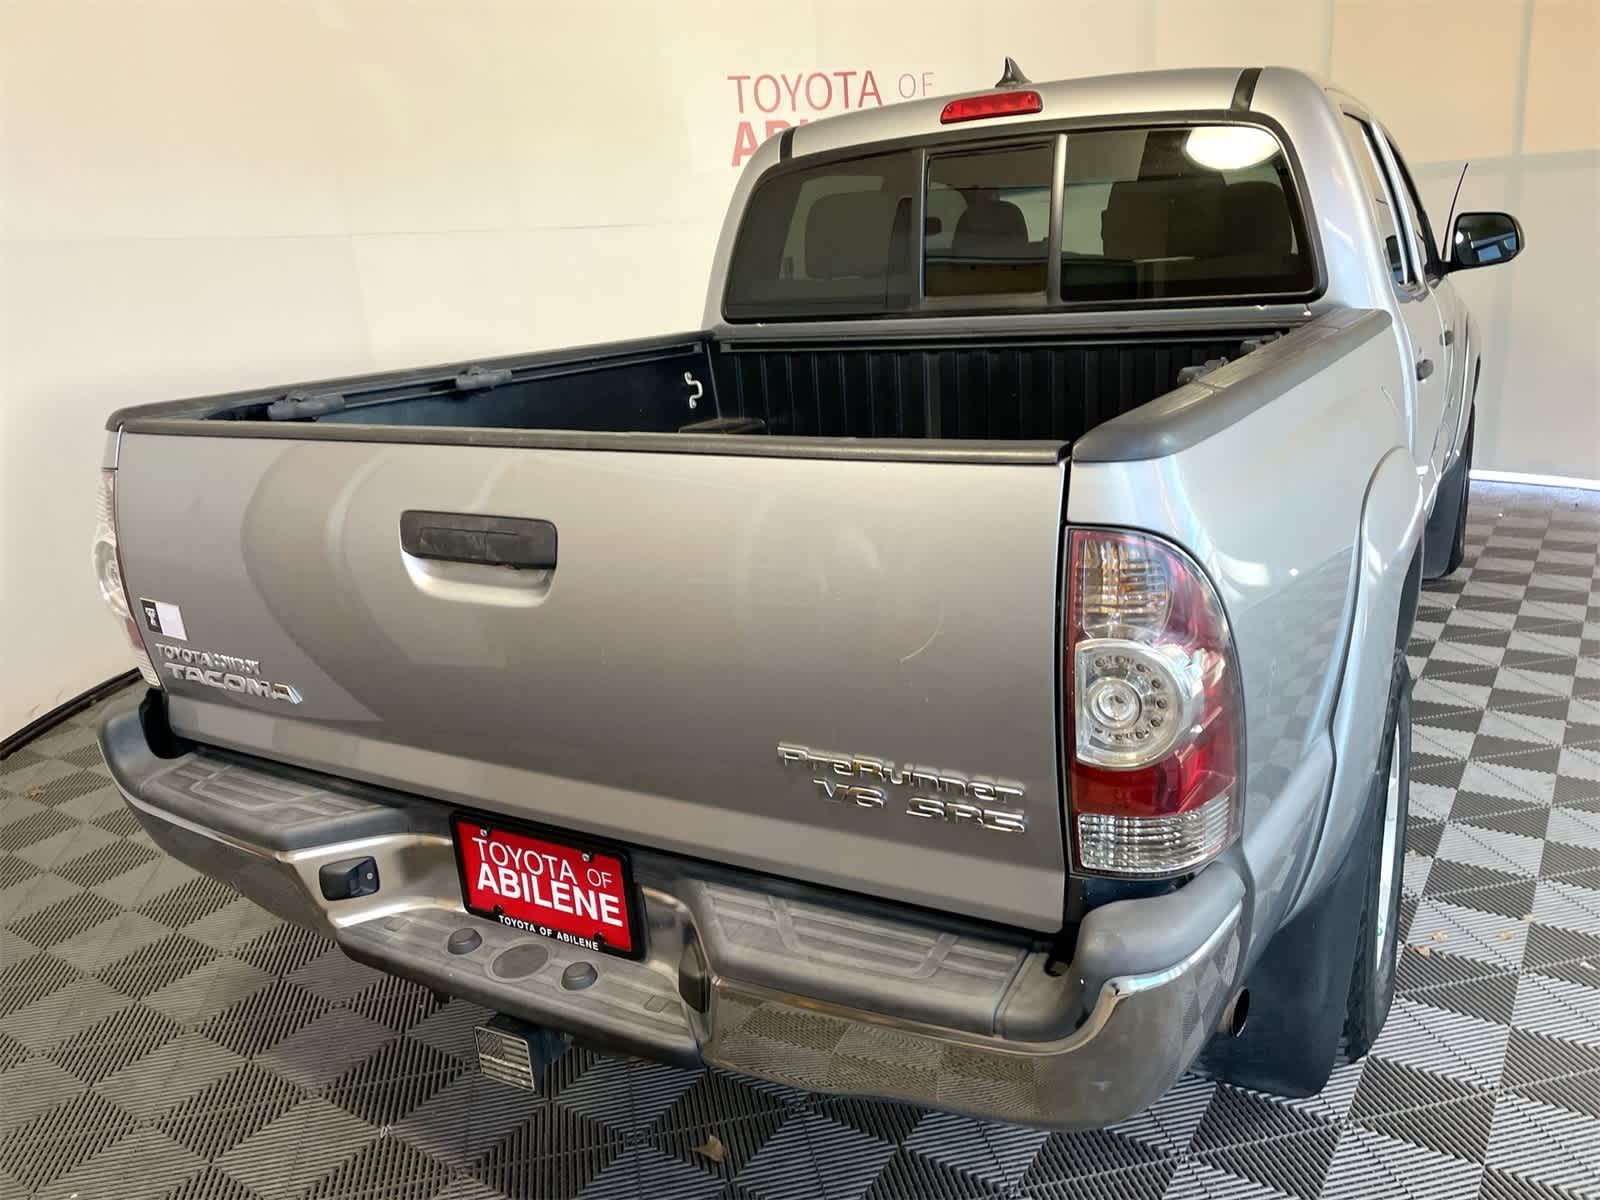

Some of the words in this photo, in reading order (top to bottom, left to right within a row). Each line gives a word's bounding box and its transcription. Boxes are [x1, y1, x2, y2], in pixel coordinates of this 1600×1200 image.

[727, 70, 884, 114] TOYOTA
[898, 72, 936, 99] OF
[155, 643, 214, 669] TOYOTA
[164, 662, 303, 704] TACOMA
[777, 742, 1025, 804] PreRunner
[813, 777, 888, 809] V6
[905, 796, 1026, 833] SR5
[472, 837, 578, 885] TOYOTA
[586, 868, 613, 889] OF
[477, 862, 624, 927] ABILENE
[499, 914, 536, 933] TOYOTA
[539, 926, 553, 937] OF
[557, 931, 599, 951] ABILENE
